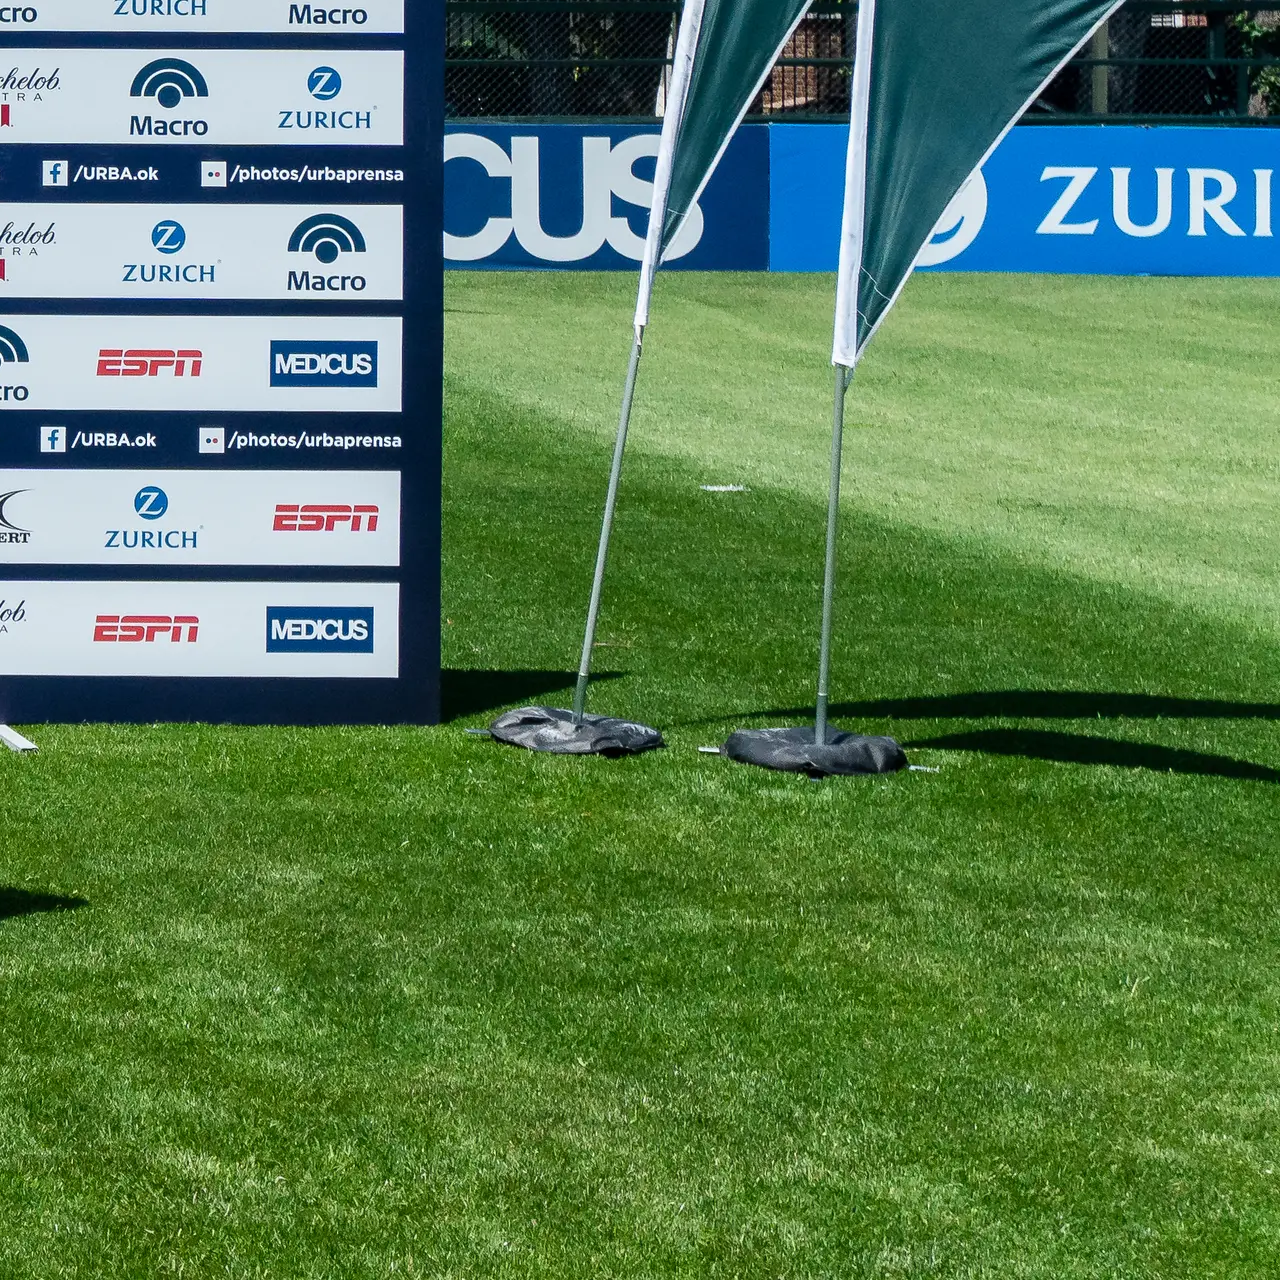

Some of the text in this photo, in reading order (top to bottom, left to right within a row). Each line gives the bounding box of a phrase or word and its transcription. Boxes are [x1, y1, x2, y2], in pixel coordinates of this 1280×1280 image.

[288, 3, 368, 25] Macro
[129, 115, 209, 137] Macro
[278, 110, 372, 130] ZURICH
[73, 164, 159, 184] /URBA.ok
[229, 162, 405, 184] /photos/urbaprensa
[122, 264, 215, 284] ZURICH
[286, 269, 367, 291] Macro
[96, 349, 203, 377] ESPN
[275, 353, 372, 376] MEDICUS
[71, 430, 157, 449] /URBA.ok
[228, 430, 402, 450] /photos/urbaprensa
[272, 504, 379, 532] ESPN
[104, 530, 198, 549] ZURICH
[93, 615, 200, 643] ESPN
[270, 618, 368, 641] MEDICUS
